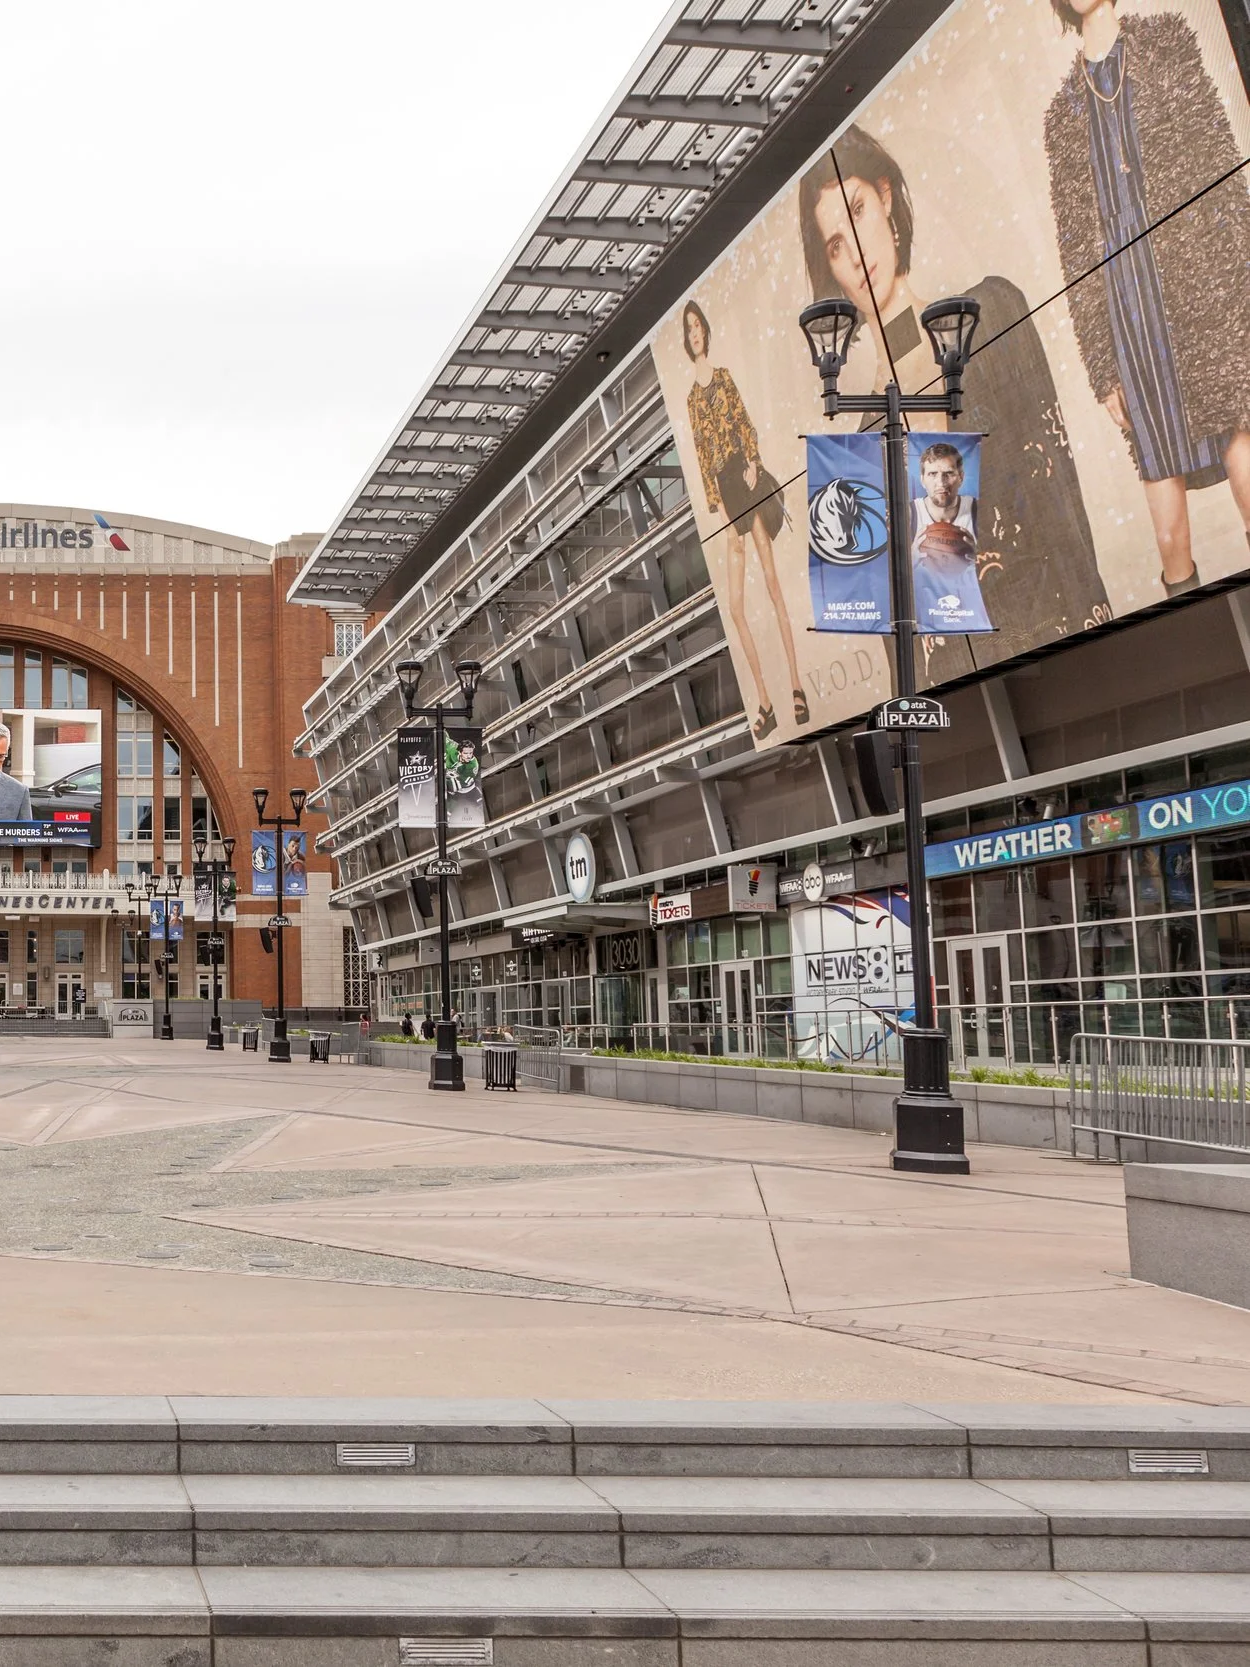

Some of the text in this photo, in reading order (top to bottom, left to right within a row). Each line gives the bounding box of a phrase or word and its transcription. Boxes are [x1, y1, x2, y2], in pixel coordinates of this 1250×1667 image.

[828, 602, 875, 611] MAVS.COM
[928, 608, 975, 617] PlainsCapital
[823, 611, 881, 620] 214.747.MAVS
[806, 649, 881, 699] V.O.D.
[910, 701, 927, 709] at&t
[889, 714, 939, 726] PLAZA
[399, 765, 433, 777] VICTORY
[954, 784, 1250, 868] WEATHER ON YO
[570, 857, 587, 880] tm
[805, 876, 821, 889] abc
[735, 902, 775, 910] TICKETS
[659, 905, 690, 920] TICKETS
[611, 936, 639, 967] 3030
[808, 946, 889, 985] NEWS 8
